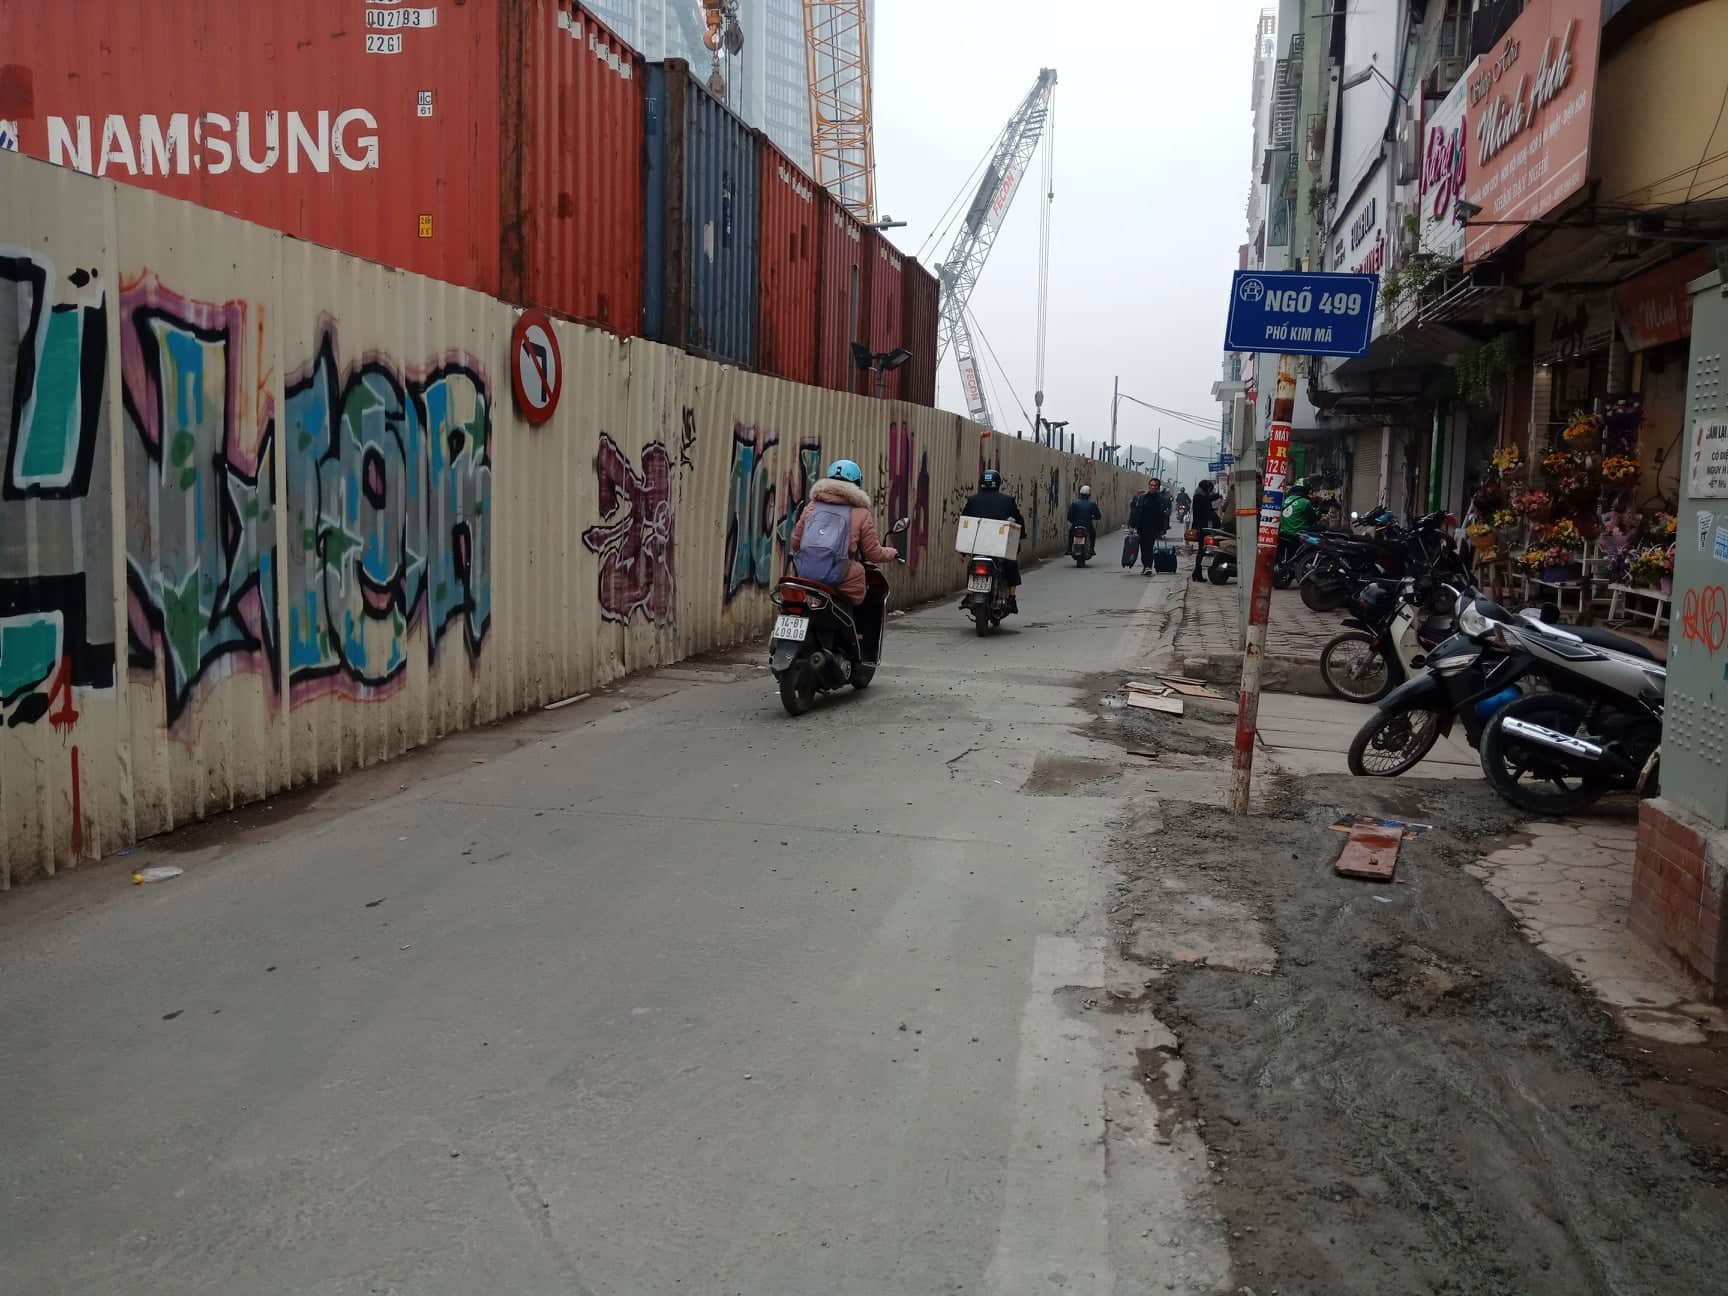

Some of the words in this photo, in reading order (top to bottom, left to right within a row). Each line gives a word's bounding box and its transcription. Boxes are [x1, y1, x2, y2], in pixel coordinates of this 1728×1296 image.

[367, 36, 401, 52] 22G1
[1477, 73, 1526, 168] Minh
[1525, 17, 1574, 129] Anh
[47, 107, 380, 178] NAMSUNG
[993, 169, 1014, 217] FECON
[1264, 286, 1312, 313] NGÕ
[1318, 292, 1362, 316] 499
[1265, 321, 1288, 340] PHỐ
[1290, 327, 1312, 342] KIM
[1314, 325, 1333, 343] MÃ
